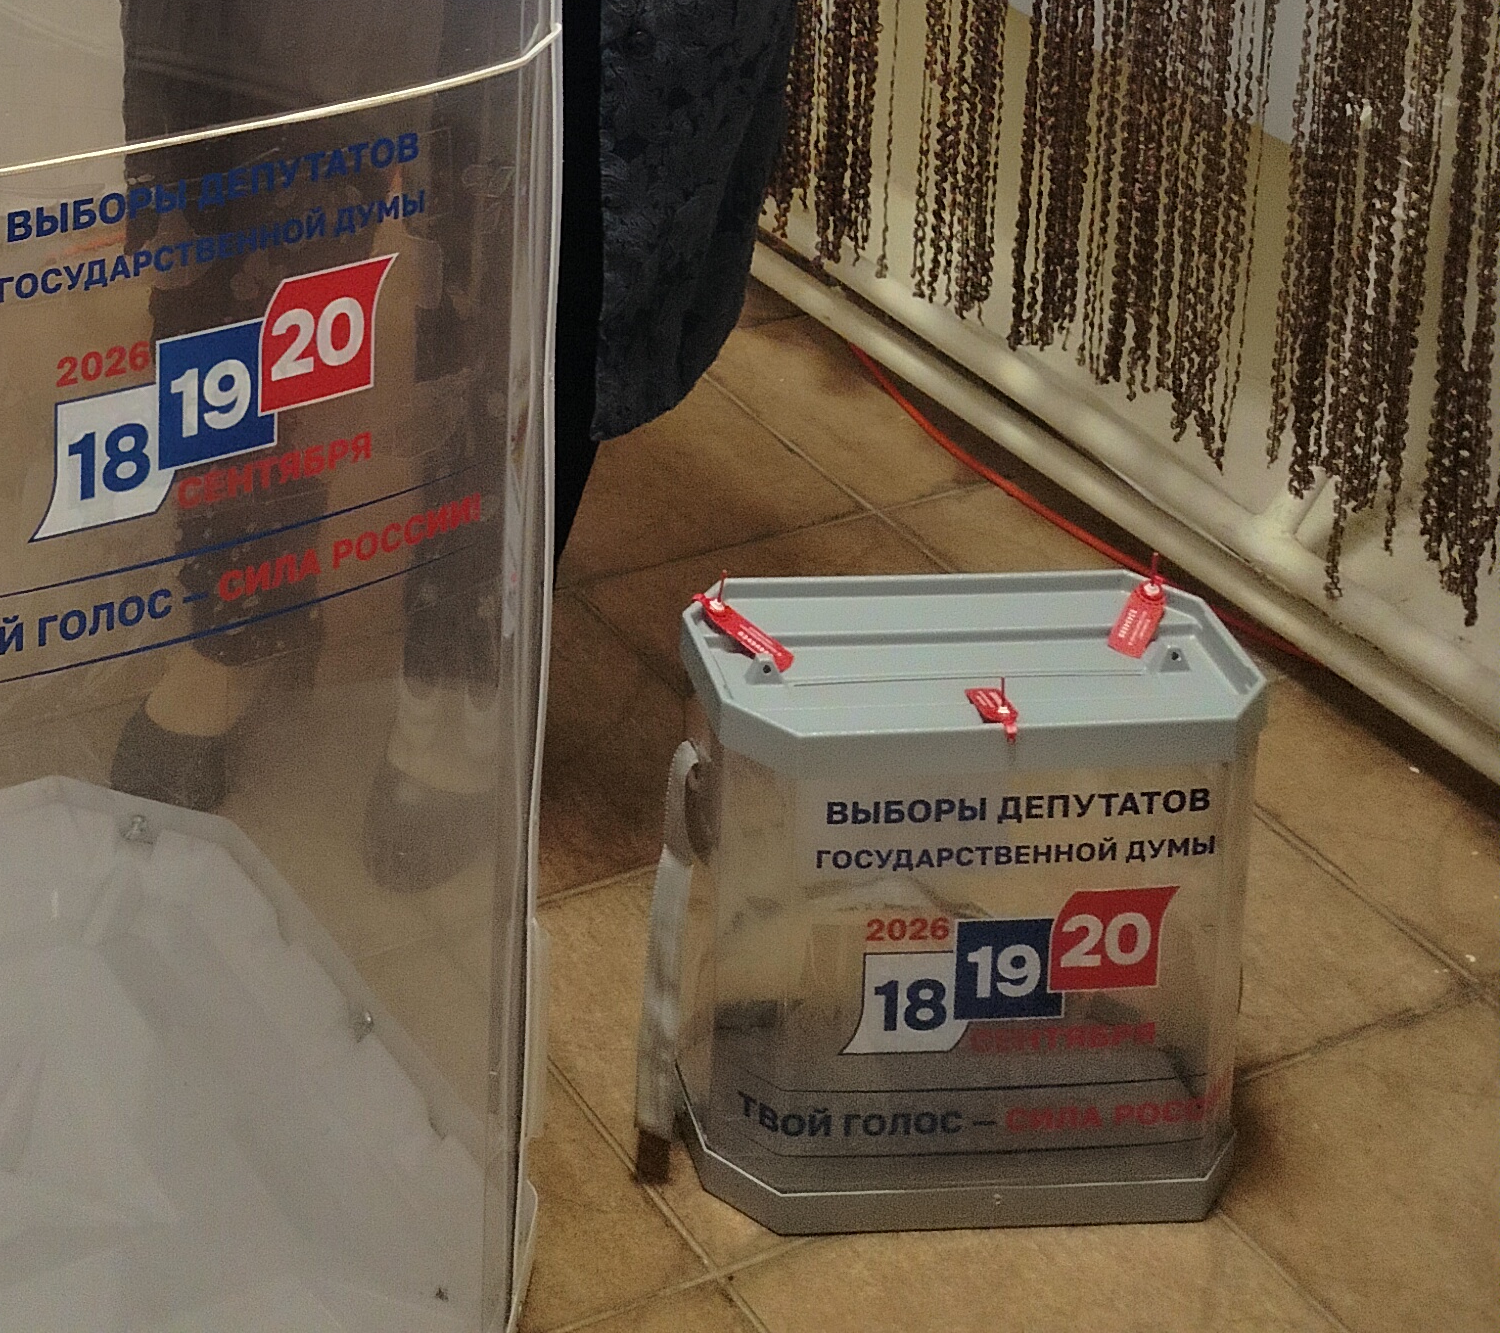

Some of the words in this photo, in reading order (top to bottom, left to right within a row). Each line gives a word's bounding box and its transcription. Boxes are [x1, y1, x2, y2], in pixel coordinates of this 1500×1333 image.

[6, 181, 186, 243] ВЫБОРЫ
[197, 133, 419, 210] ДЕПУТАТОВ
[333, 190, 425, 238] ДУМЫ
[56, 340, 150, 387] 2026
[68, 422, 151, 501] 18
[170, 359, 251, 439] 19
[271, 297, 365, 382] 20
[177, 432, 373, 510] СЕНТЯБРЯ
[37, 588, 173, 648] ГОЛОС
[218, 550, 322, 602] СИЛА
[332, 493, 483, 570] РОССИИ!
[826, 797, 987, 826] ВЫБОРЫ
[997, 787, 1211, 824] ДЕПУТАТОВ
[815, 837, 1117, 872] ГОСУДАРСТВЕННОЙ
[1125, 835, 1216, 864] ДУМЫ
[865, 917, 949, 942] 2026
[874, 978, 947, 1032] 18
[967, 944, 1041, 999] 19
[1060, 912, 1151, 968] 20
[737, 1090, 832, 1137] ТВОЙ
[843, 1110, 964, 1137] ГОЛОС
[1005, 1104, 1102, 1133] СИЛА
